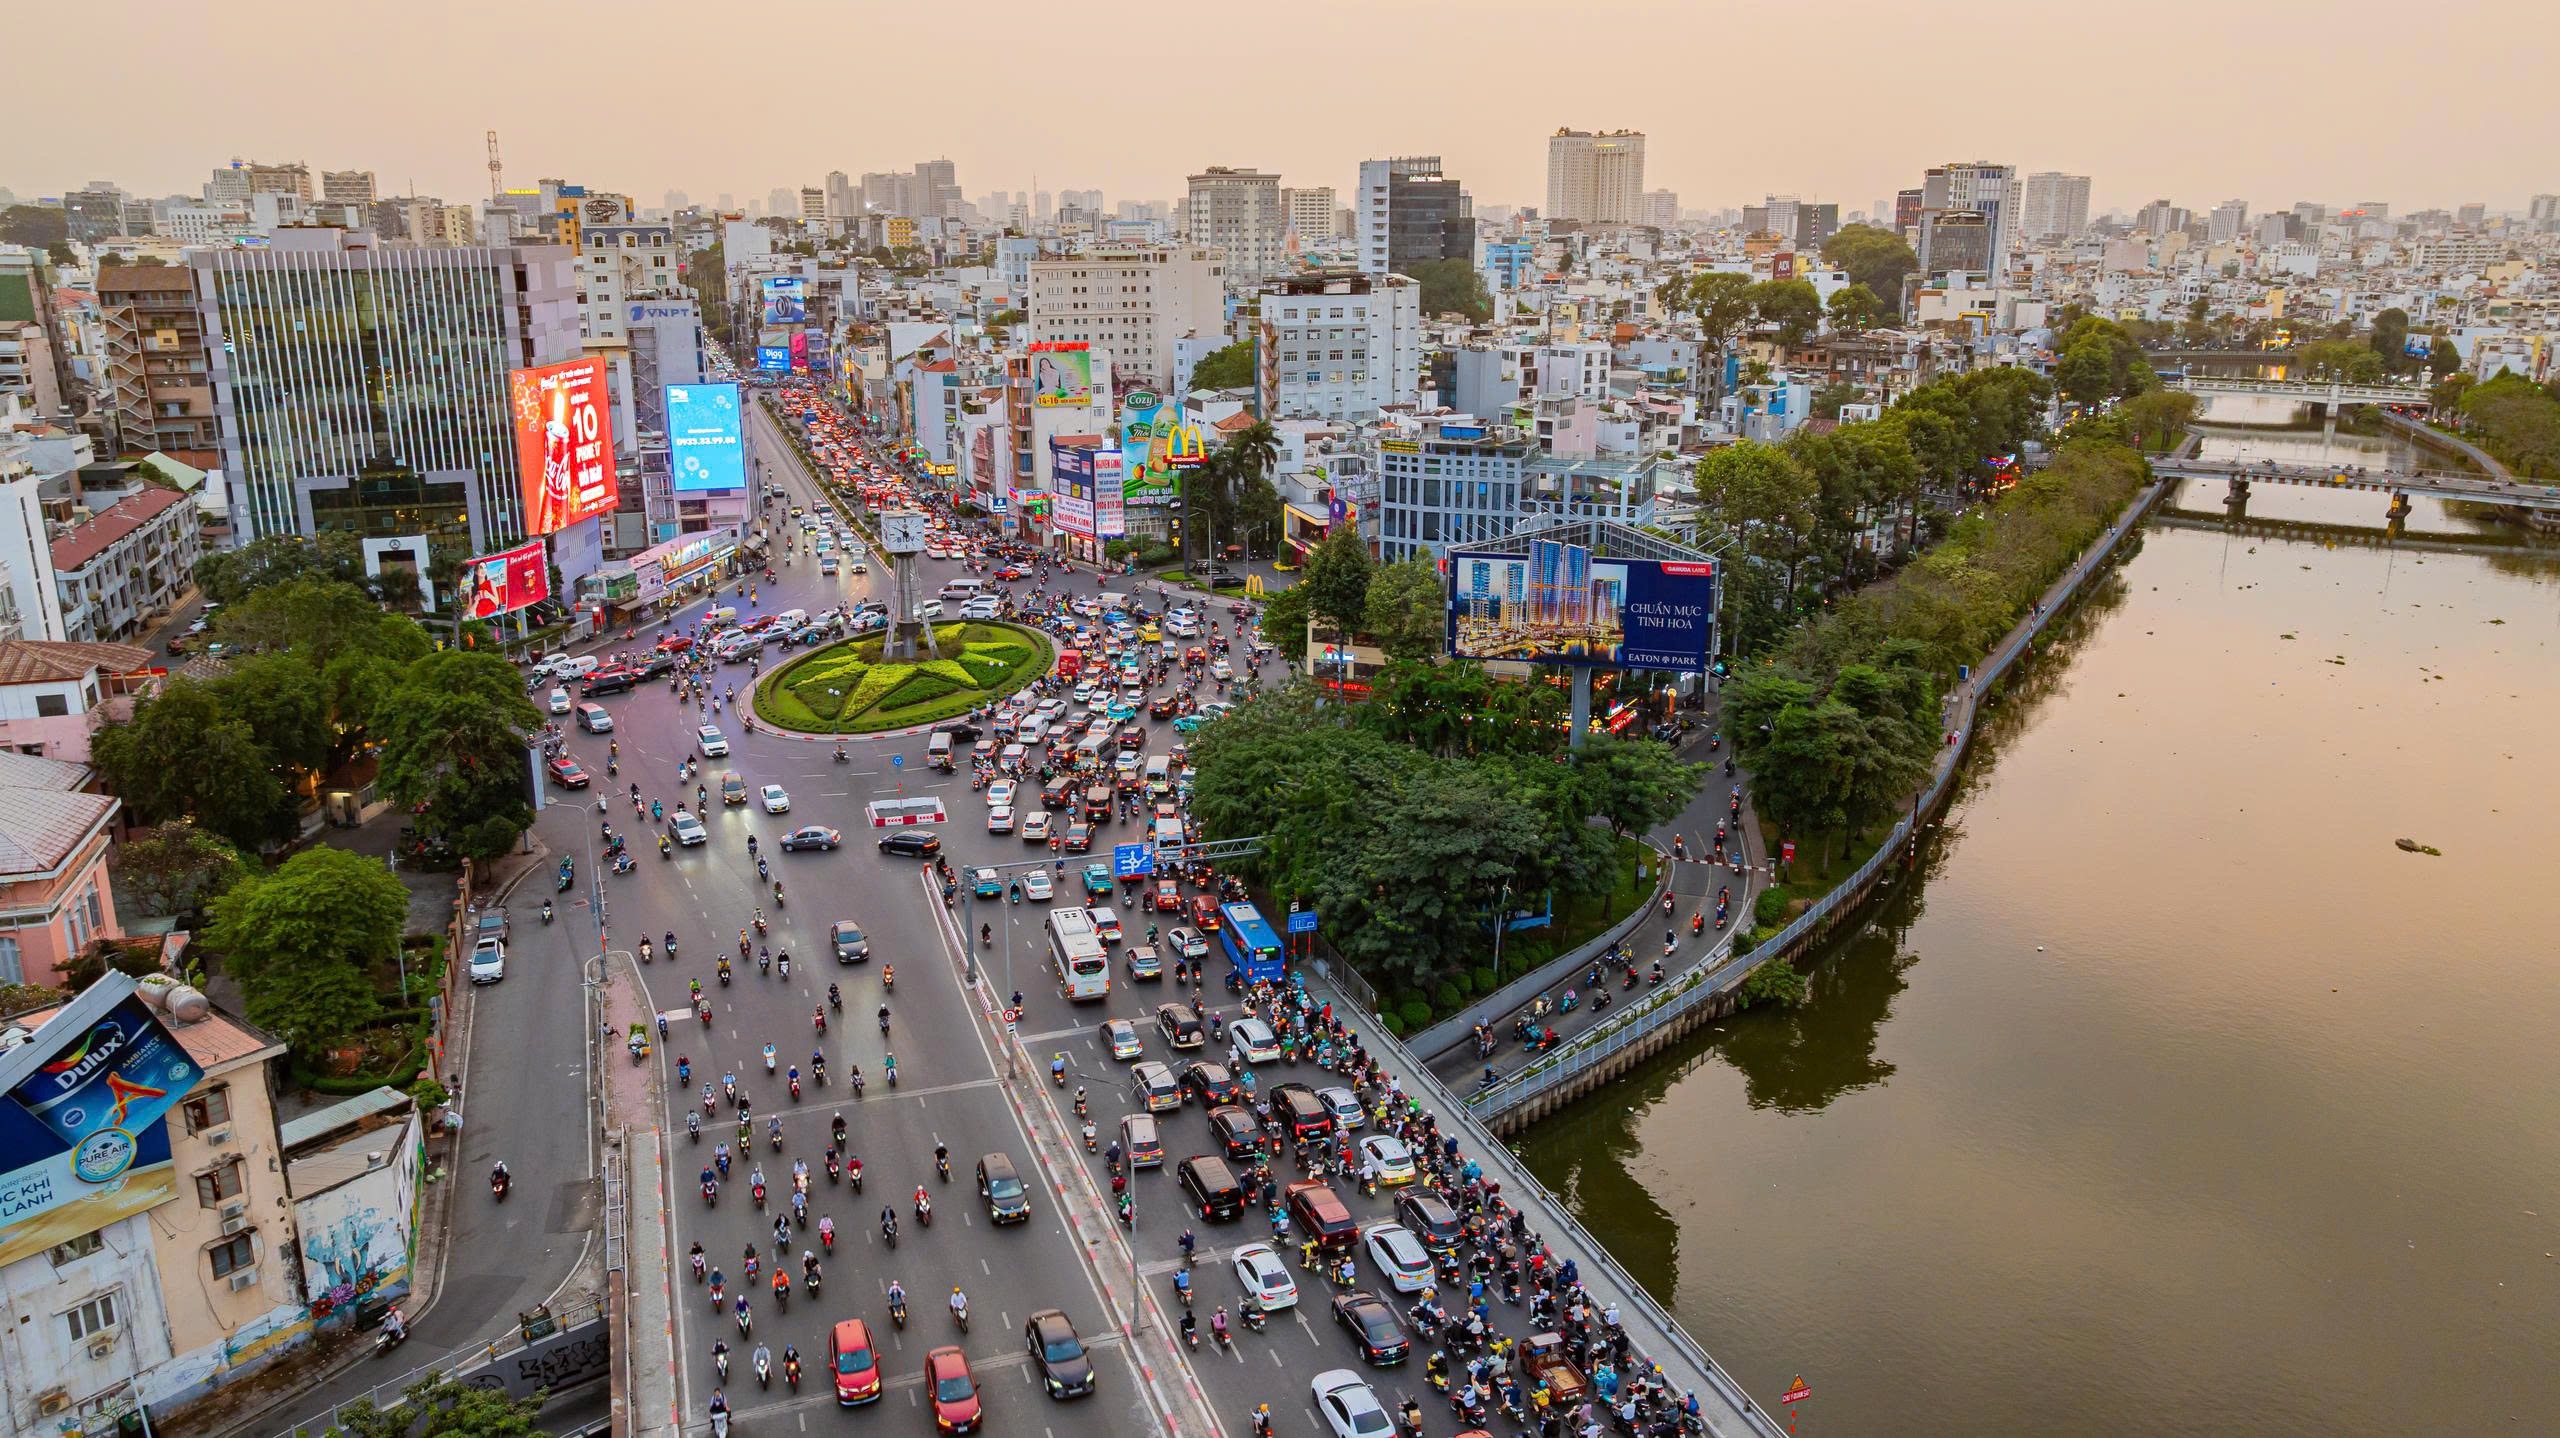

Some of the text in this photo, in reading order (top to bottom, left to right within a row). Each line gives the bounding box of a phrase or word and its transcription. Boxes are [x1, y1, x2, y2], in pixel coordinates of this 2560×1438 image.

[646, 308, 690, 318] VNPT
[1129, 395, 1153, 406] Cozy
[573, 404, 598, 443] 10
[1630, 601, 1702, 618] CHUẨN MỰC
[1637, 616, 1693, 629] TINH HOA
[1628, 653, 1697, 665] EATON PARK
[122, 1034, 161, 1069] AMBIANCE
[54, 1037, 123, 1090] Dulux
[78, 1142, 130, 1166] PURE AIR
